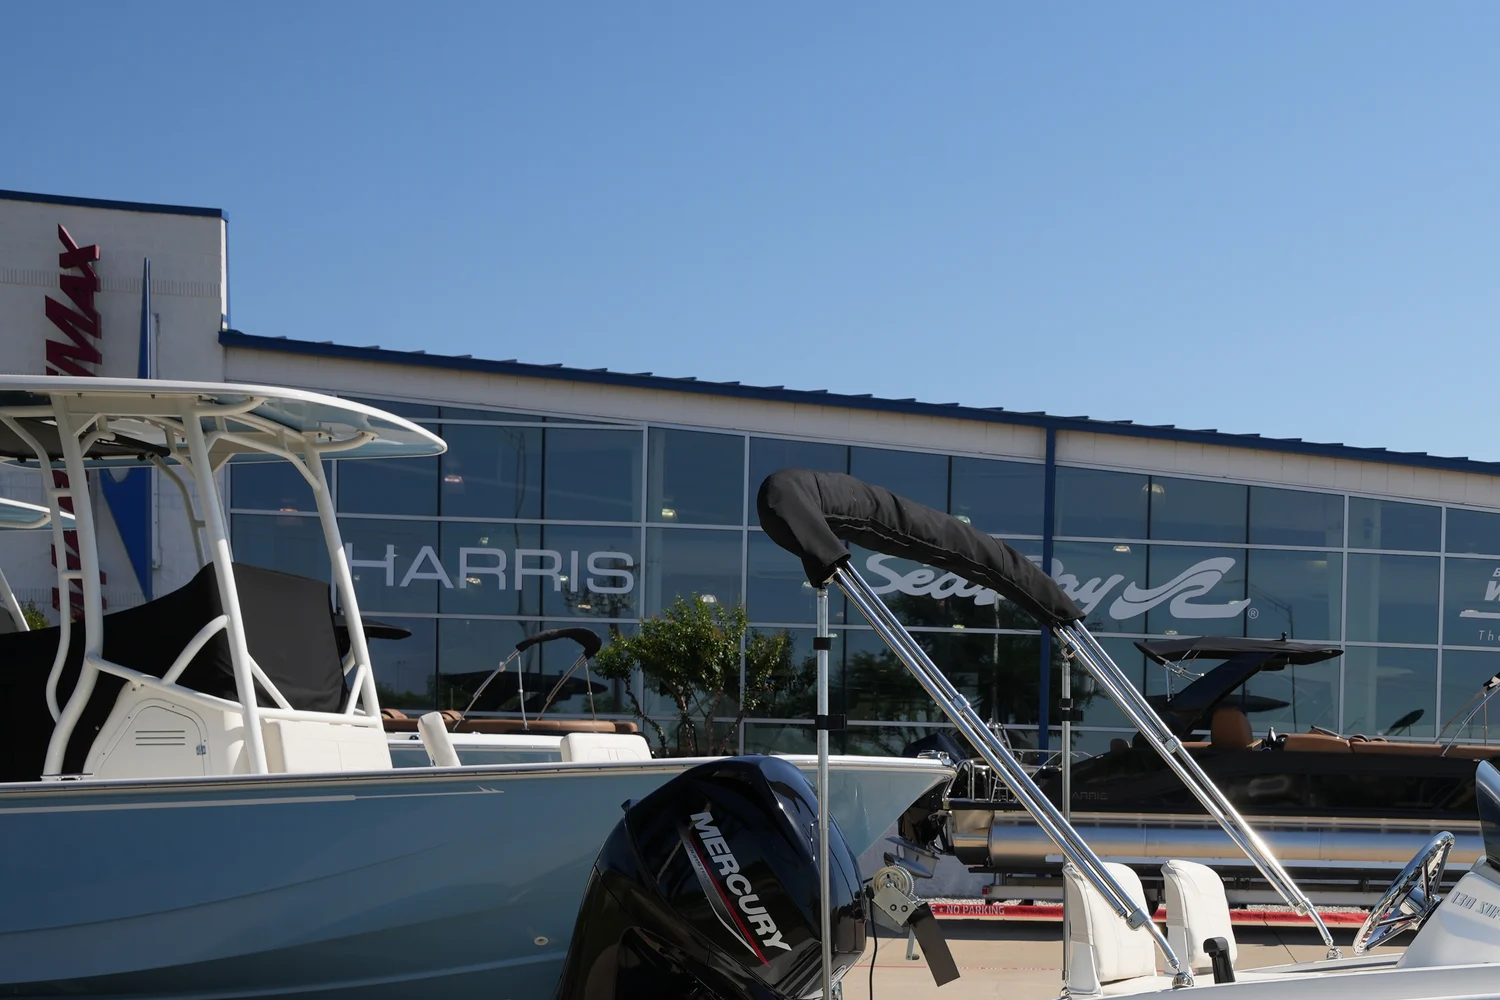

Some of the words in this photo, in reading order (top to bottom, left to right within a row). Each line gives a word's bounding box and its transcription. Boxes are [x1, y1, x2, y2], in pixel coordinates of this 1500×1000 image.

[345, 543, 634, 594] HARRIS
[690, 811, 793, 952] MERCURY
[946, 904, 960, 914] NO
[962, 905, 1005, 915] PARKING
[1451, 891, 1477, 909] 130
